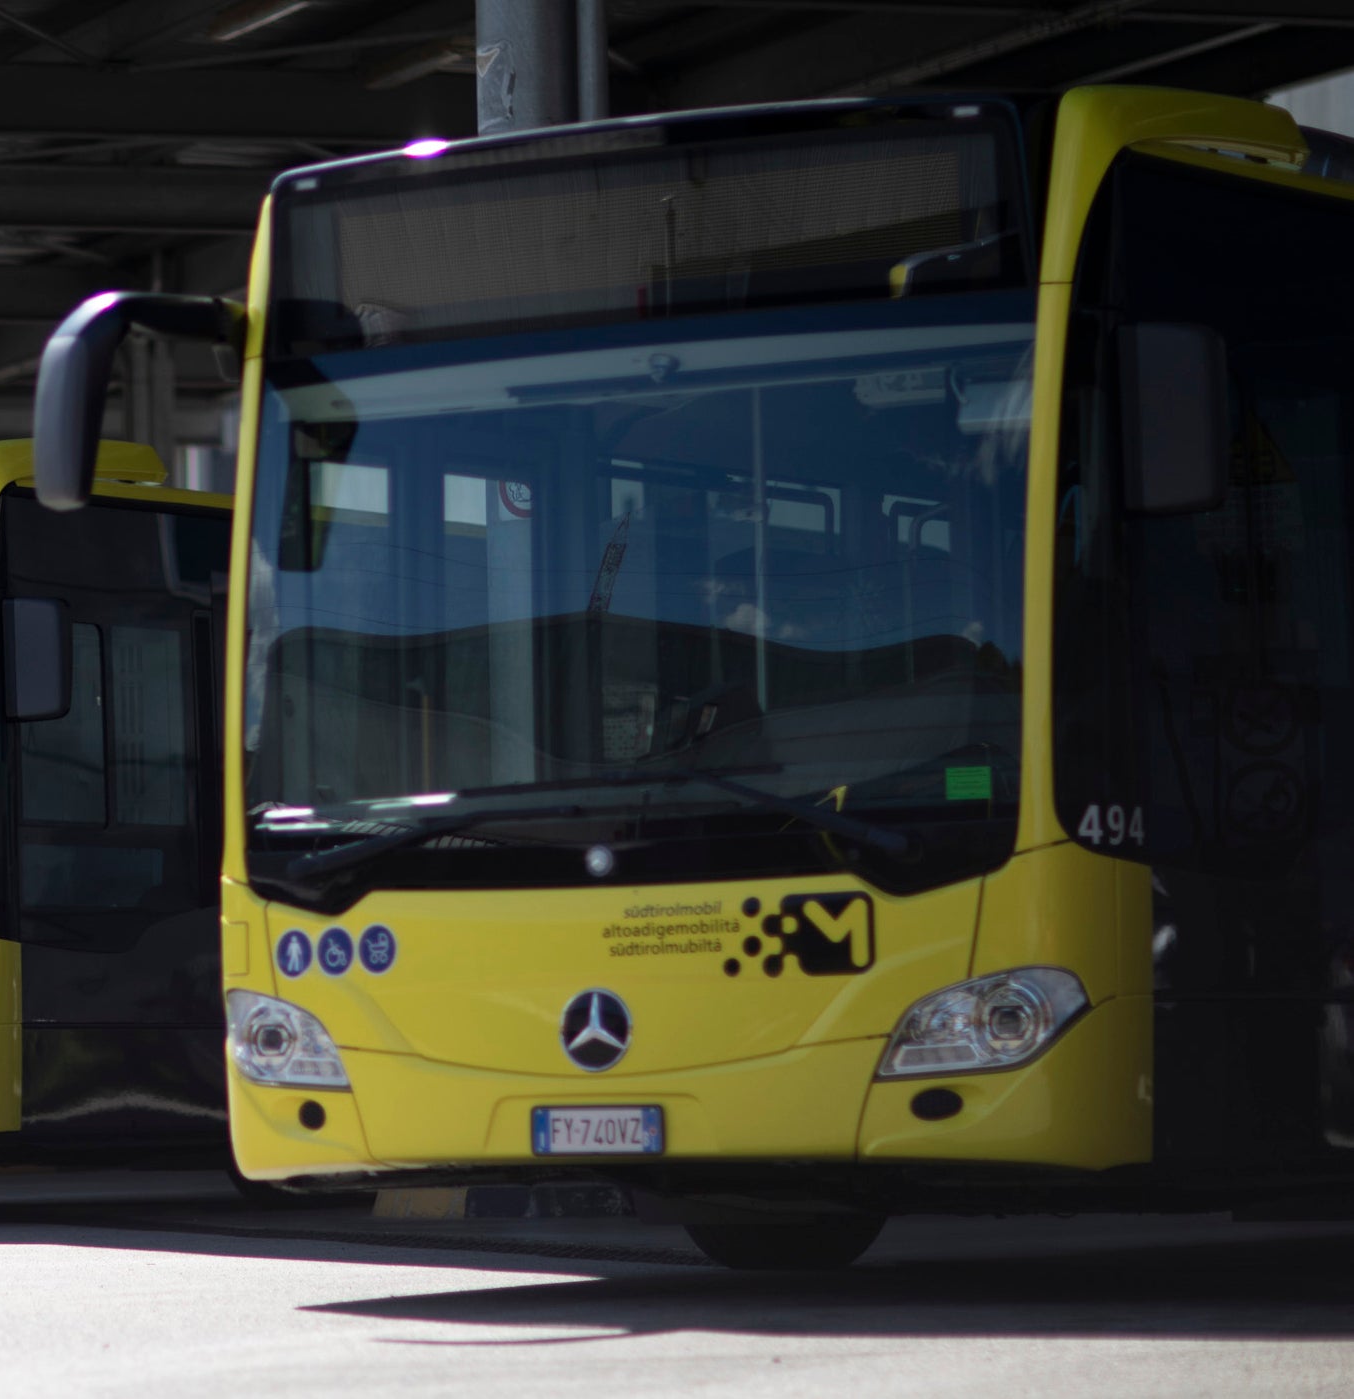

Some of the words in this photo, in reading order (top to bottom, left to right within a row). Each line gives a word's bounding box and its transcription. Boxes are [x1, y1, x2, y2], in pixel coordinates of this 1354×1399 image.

[1077, 803, 1146, 847] 494
[624, 900, 723, 919] südtirolmobil
[602, 918, 741, 940] altoadigemobilità
[609, 937, 723, 957] südtirolmubiltà
